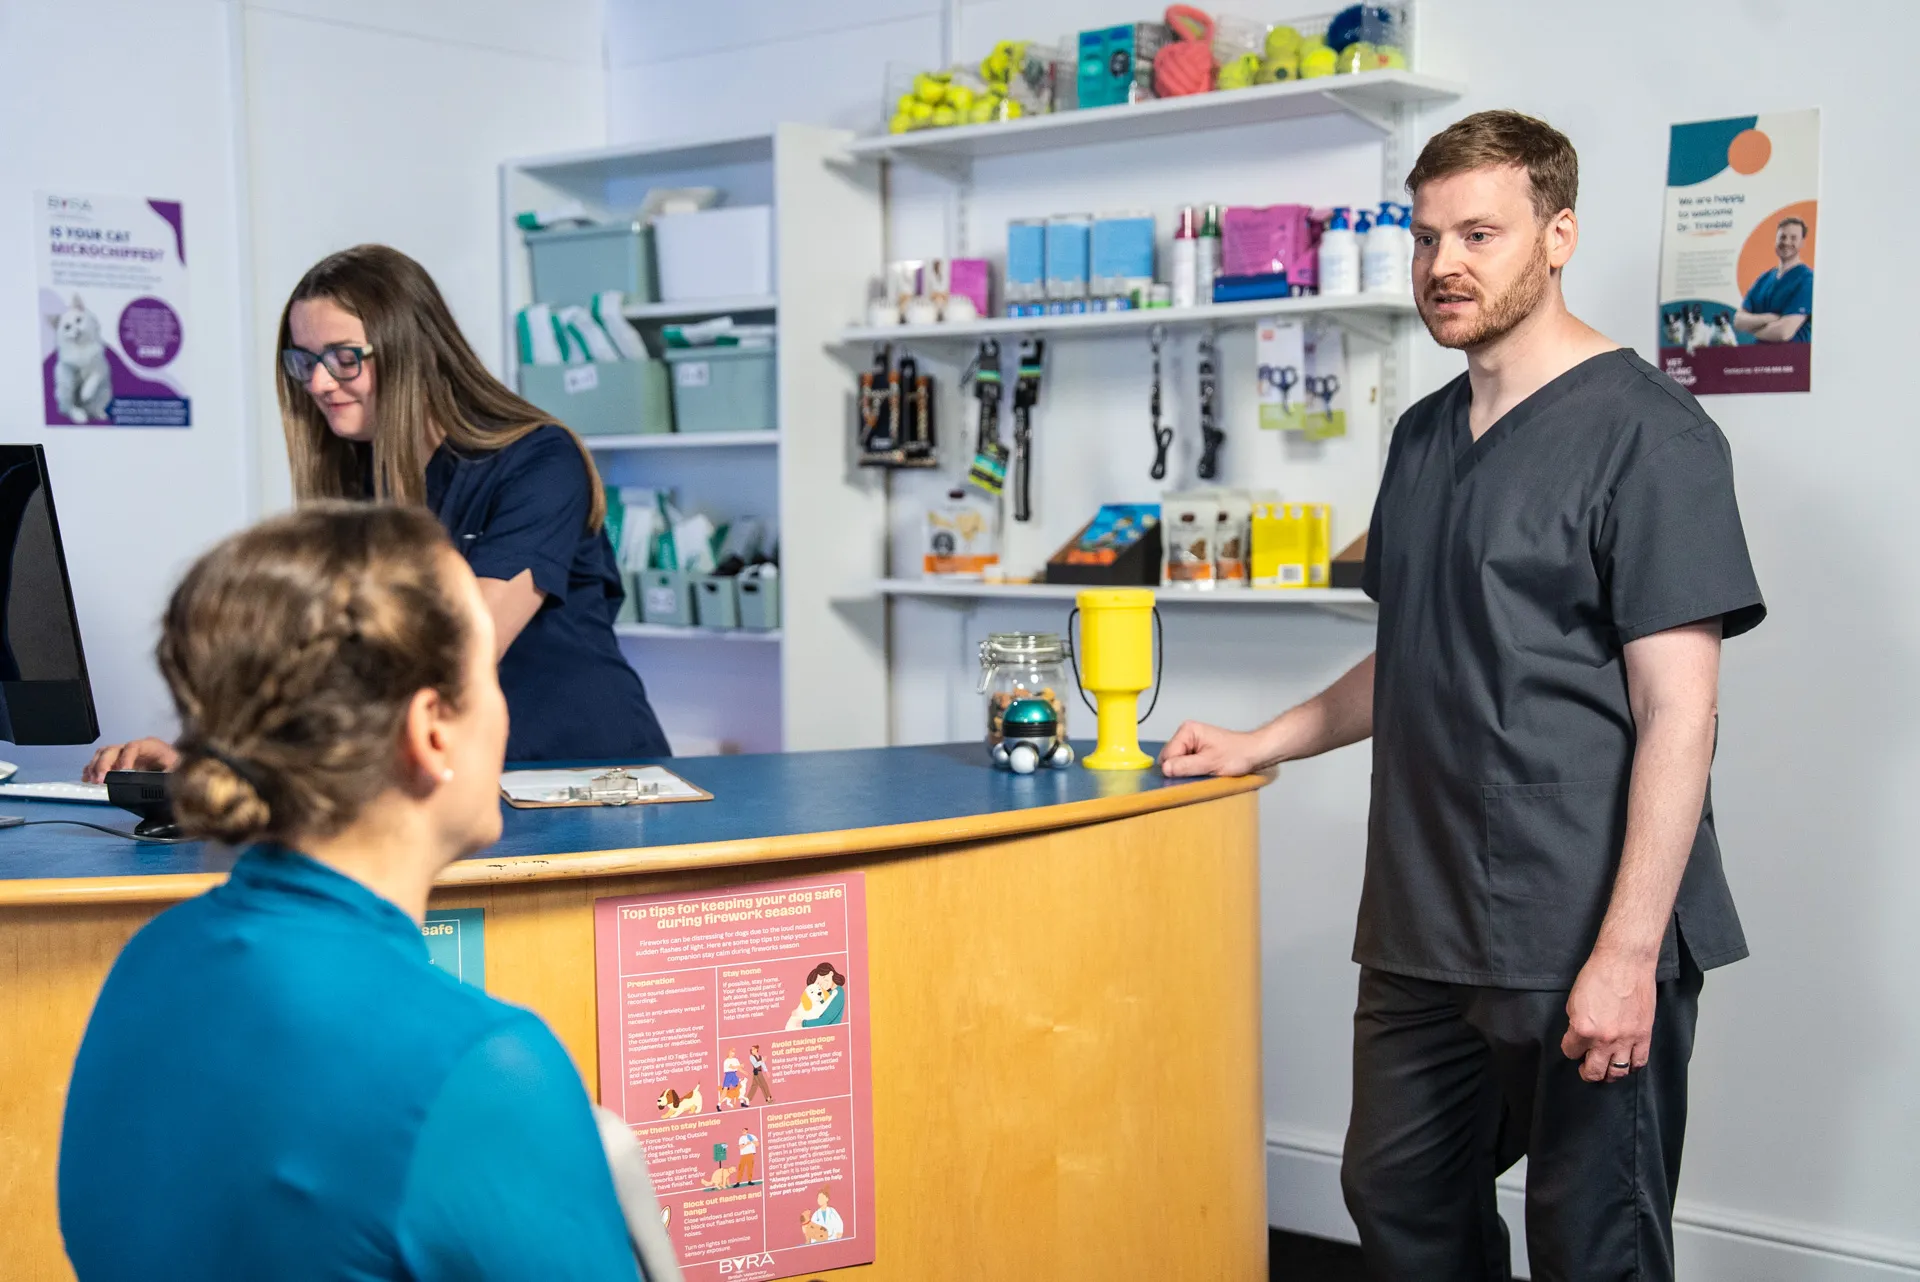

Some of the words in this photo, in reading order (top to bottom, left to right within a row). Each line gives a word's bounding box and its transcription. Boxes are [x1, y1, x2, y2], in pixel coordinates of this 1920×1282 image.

[66, 227, 101, 240] YOUR
[106, 230, 131, 242] CAT
[622, 910, 647, 919] Top
[650, 907, 675, 917] tips
[678, 904, 699, 913] for
[702, 899, 753, 911] keeping
[756, 896, 786, 906] your
[789, 893, 812, 902] dog
[815, 889, 842, 900] safe
[658, 917, 702, 929] during
[705, 910, 762, 923] firework
[766, 906, 811, 917] season
[421, 924, 454, 936] safe
[627, 978, 675, 987] Preparation
[784, 1108, 826, 1119] prescribed
[698, 1119, 721, 1127] inside
[768, 1119, 808, 1129] medication
[719, 1194, 747, 1202] flashes
[684, 1208, 707, 1216] bangs
